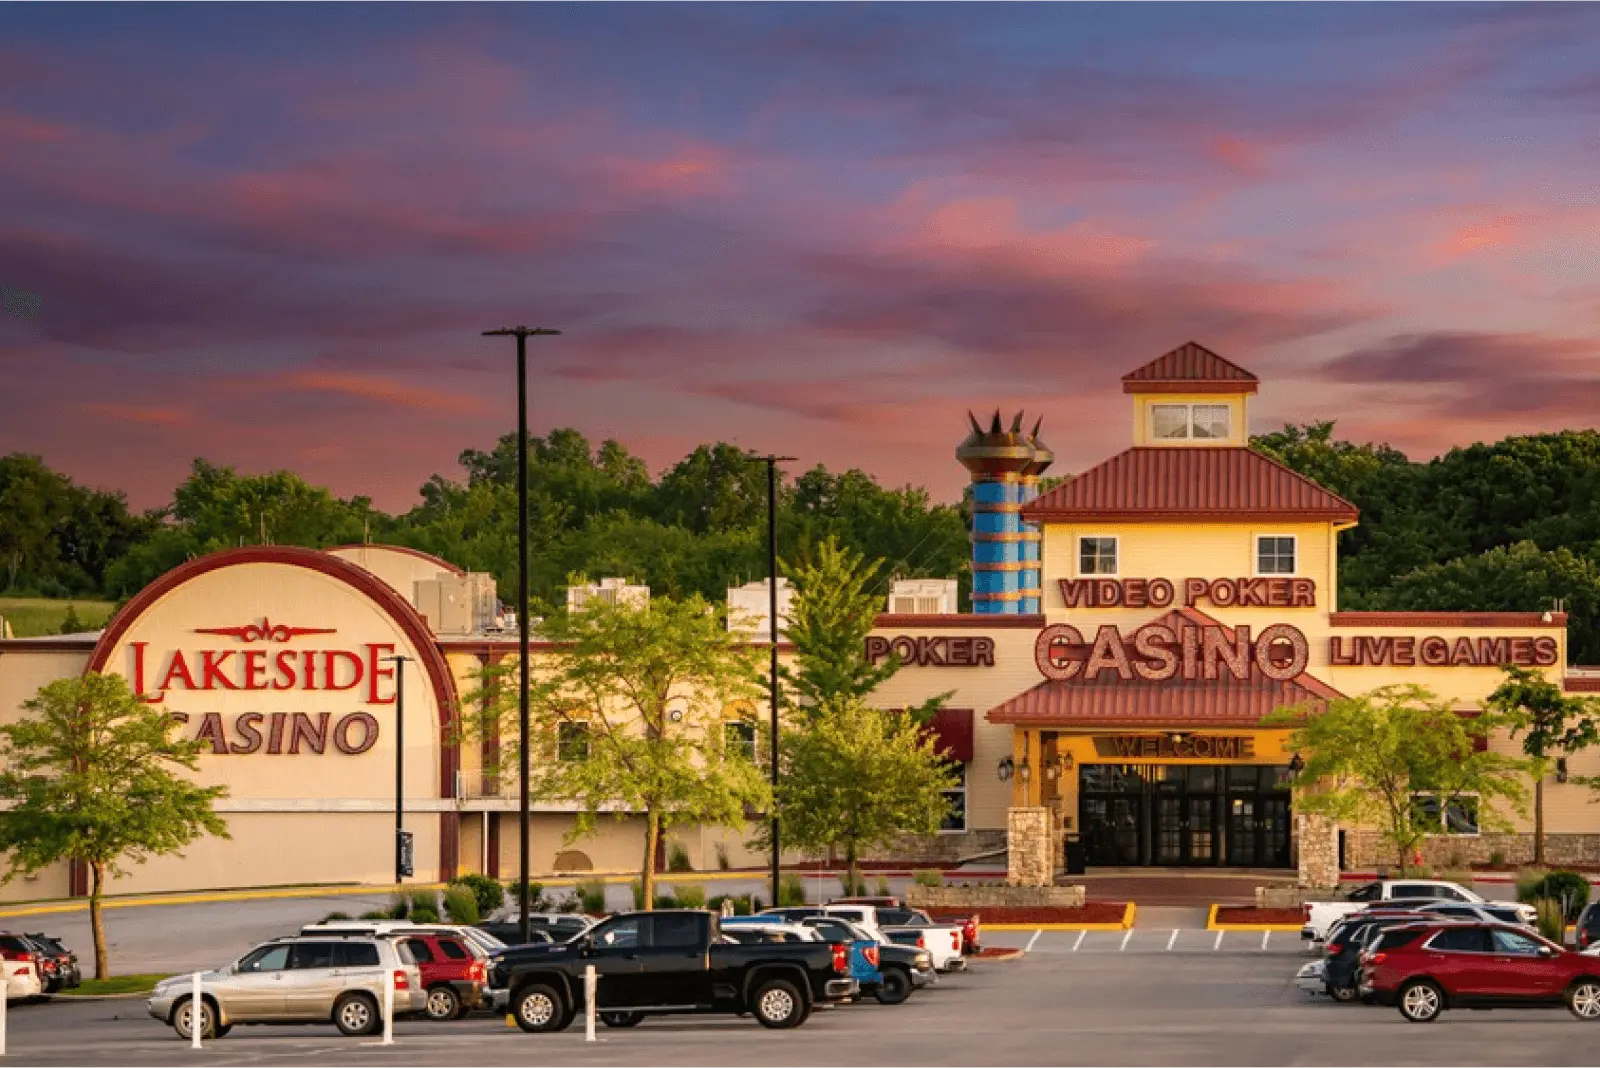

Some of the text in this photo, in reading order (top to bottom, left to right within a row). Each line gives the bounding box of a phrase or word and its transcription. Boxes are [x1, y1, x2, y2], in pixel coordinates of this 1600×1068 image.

[1059, 577, 1317, 609] VIDEO POKER
[864, 634, 996, 668] POKER
[1034, 623, 1309, 681] CASINO
[1328, 635, 1558, 666] LIVE GAMES
[129, 641, 396, 704] LAKESIDE
[1106, 735, 1256, 759] WELCOME
